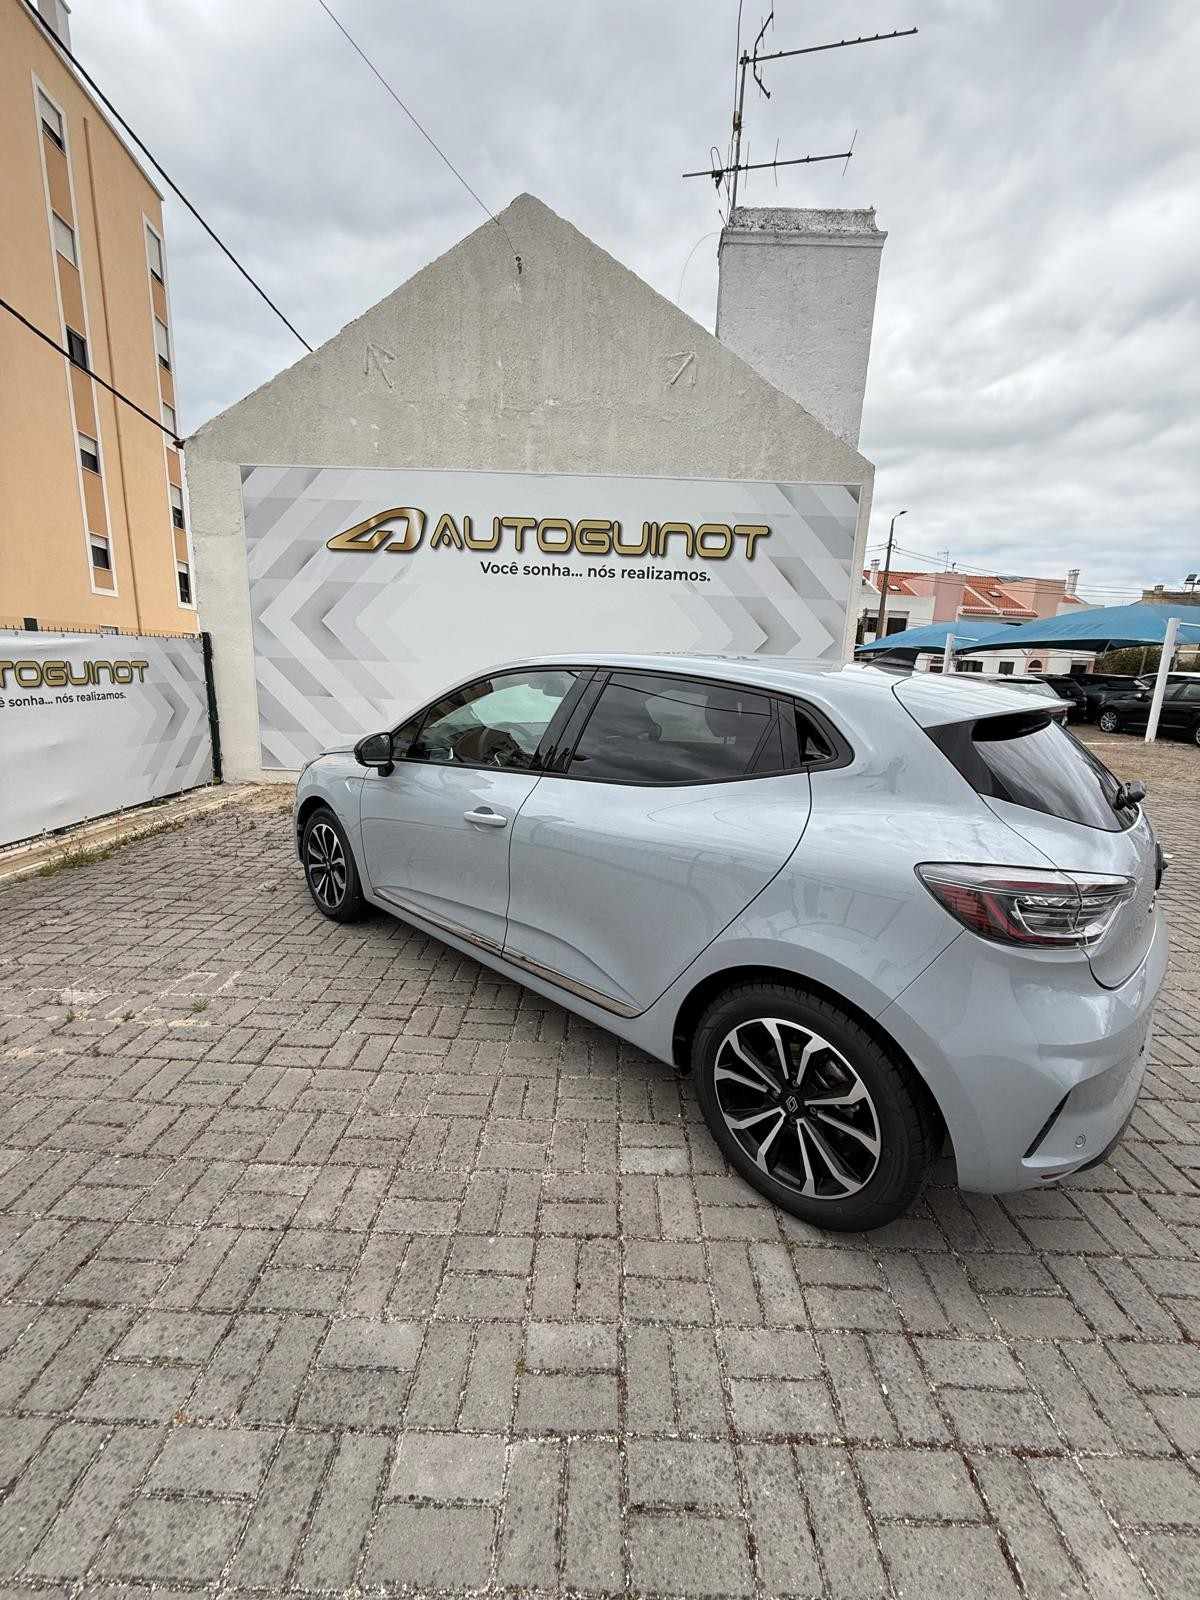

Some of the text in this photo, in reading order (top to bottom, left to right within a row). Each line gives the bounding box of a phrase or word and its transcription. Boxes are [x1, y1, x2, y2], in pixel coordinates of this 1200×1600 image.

[480, 561, 711, 582] Você sonha... nós realizamos.
[8, 695, 53, 707] sonha...
[55, 692, 74, 704] nós
[76, 691, 127, 702] realizamos.
